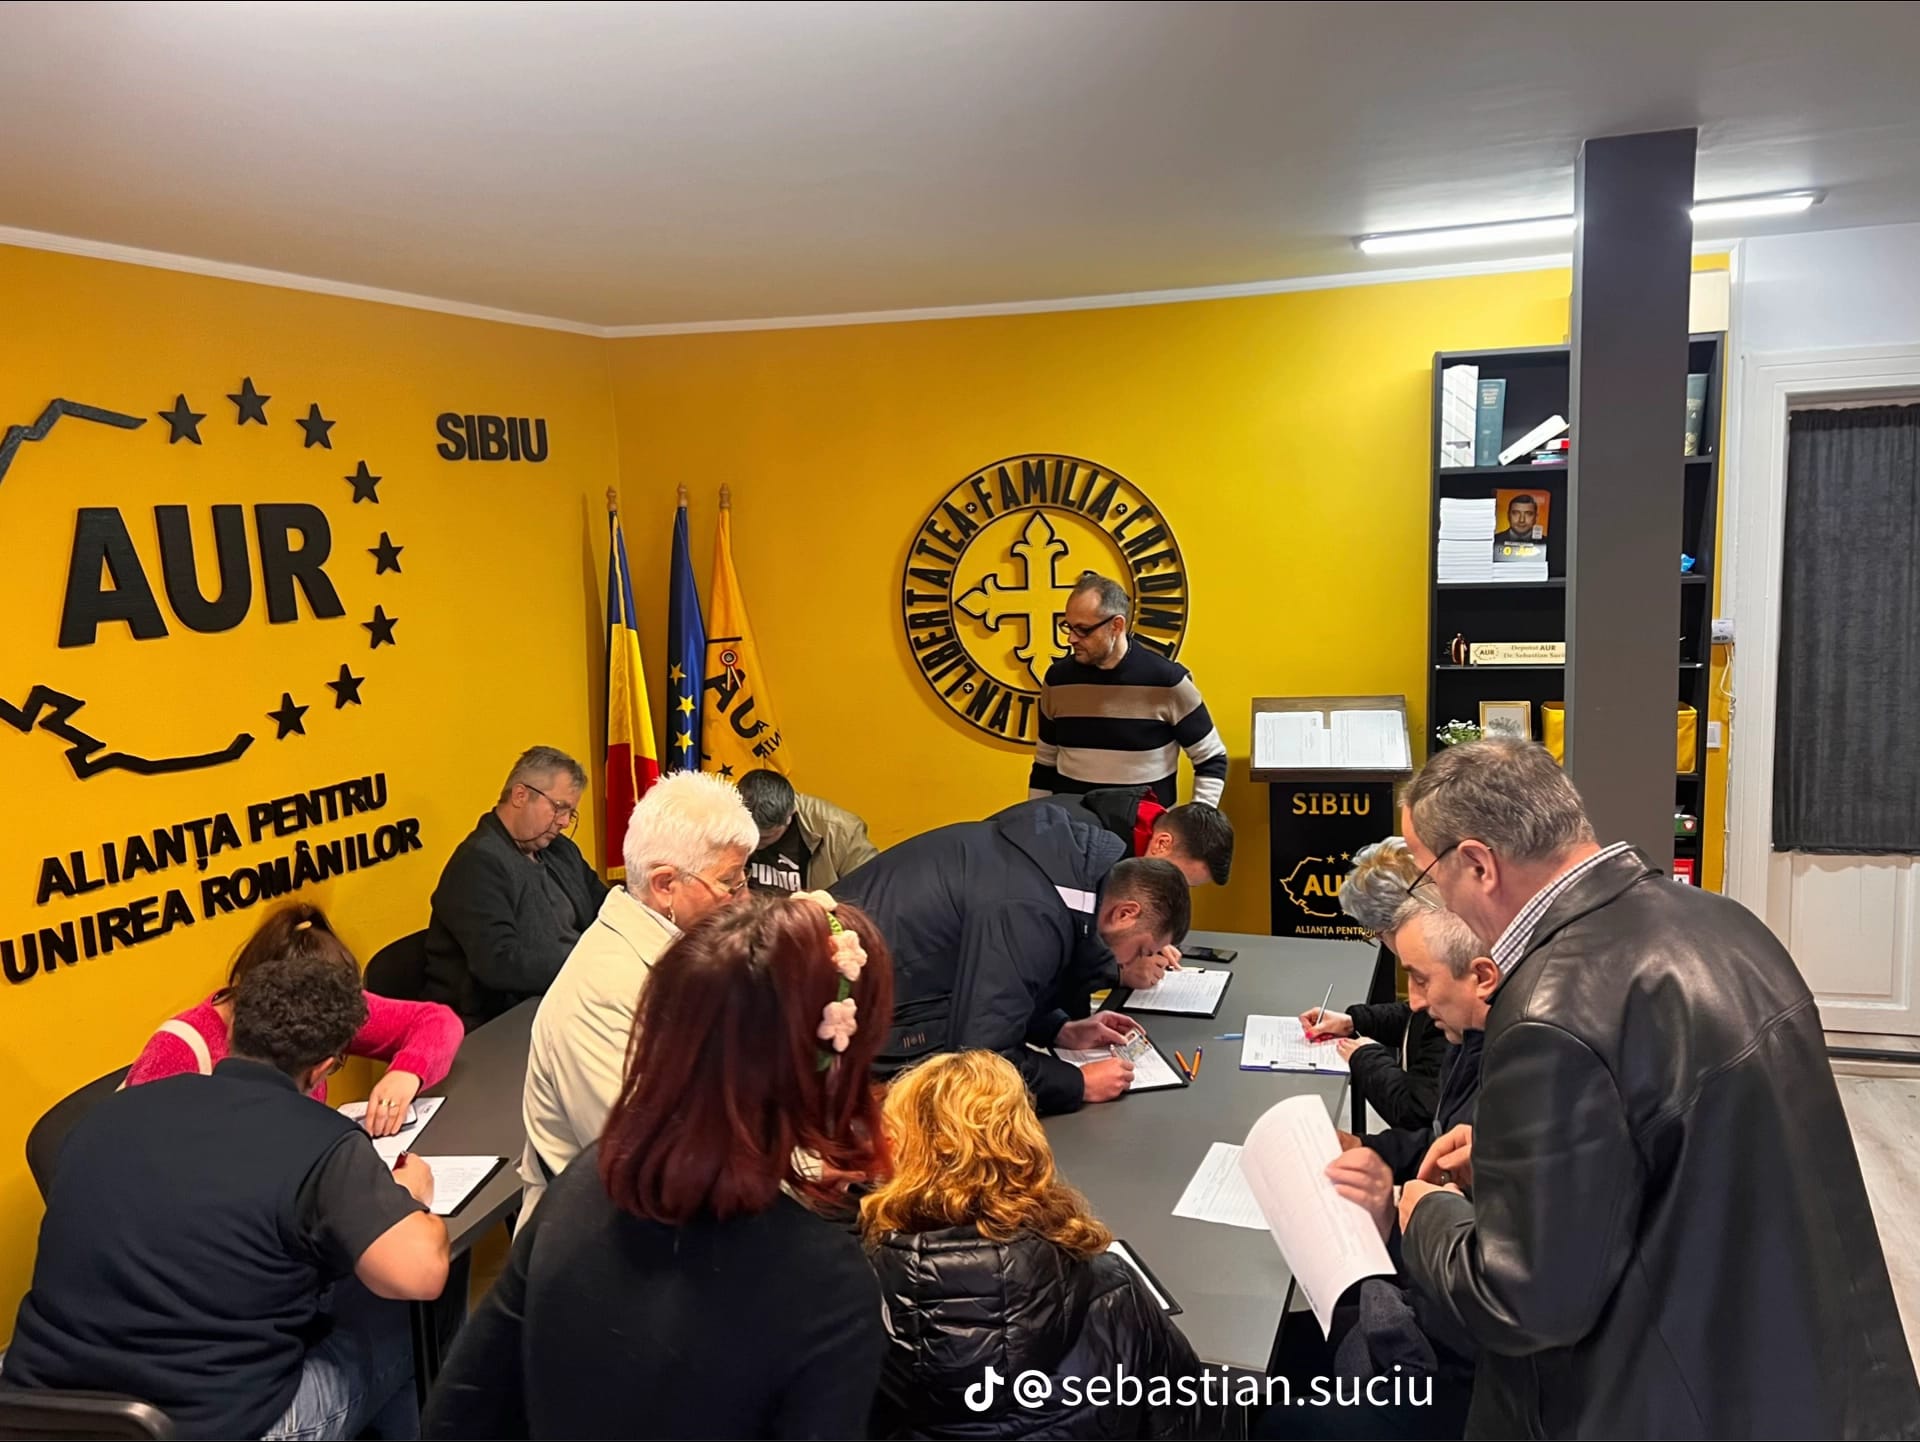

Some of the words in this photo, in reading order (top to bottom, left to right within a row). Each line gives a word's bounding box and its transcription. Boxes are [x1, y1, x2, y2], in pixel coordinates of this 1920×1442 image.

[437, 412, 549, 462] SIBIU
[57, 503, 346, 648] AUR
[907, 501, 979, 697] LIBERTATEA
[970, 459, 1120, 522] FAMILIA
[964, 679, 1035, 739] NAT
[247, 773, 389, 843] PENTRU
[1292, 792, 1370, 816] SIBIU
[0, 888, 195, 984] UNIREA
[199, 816, 423, 919] ROMÂNILOR
